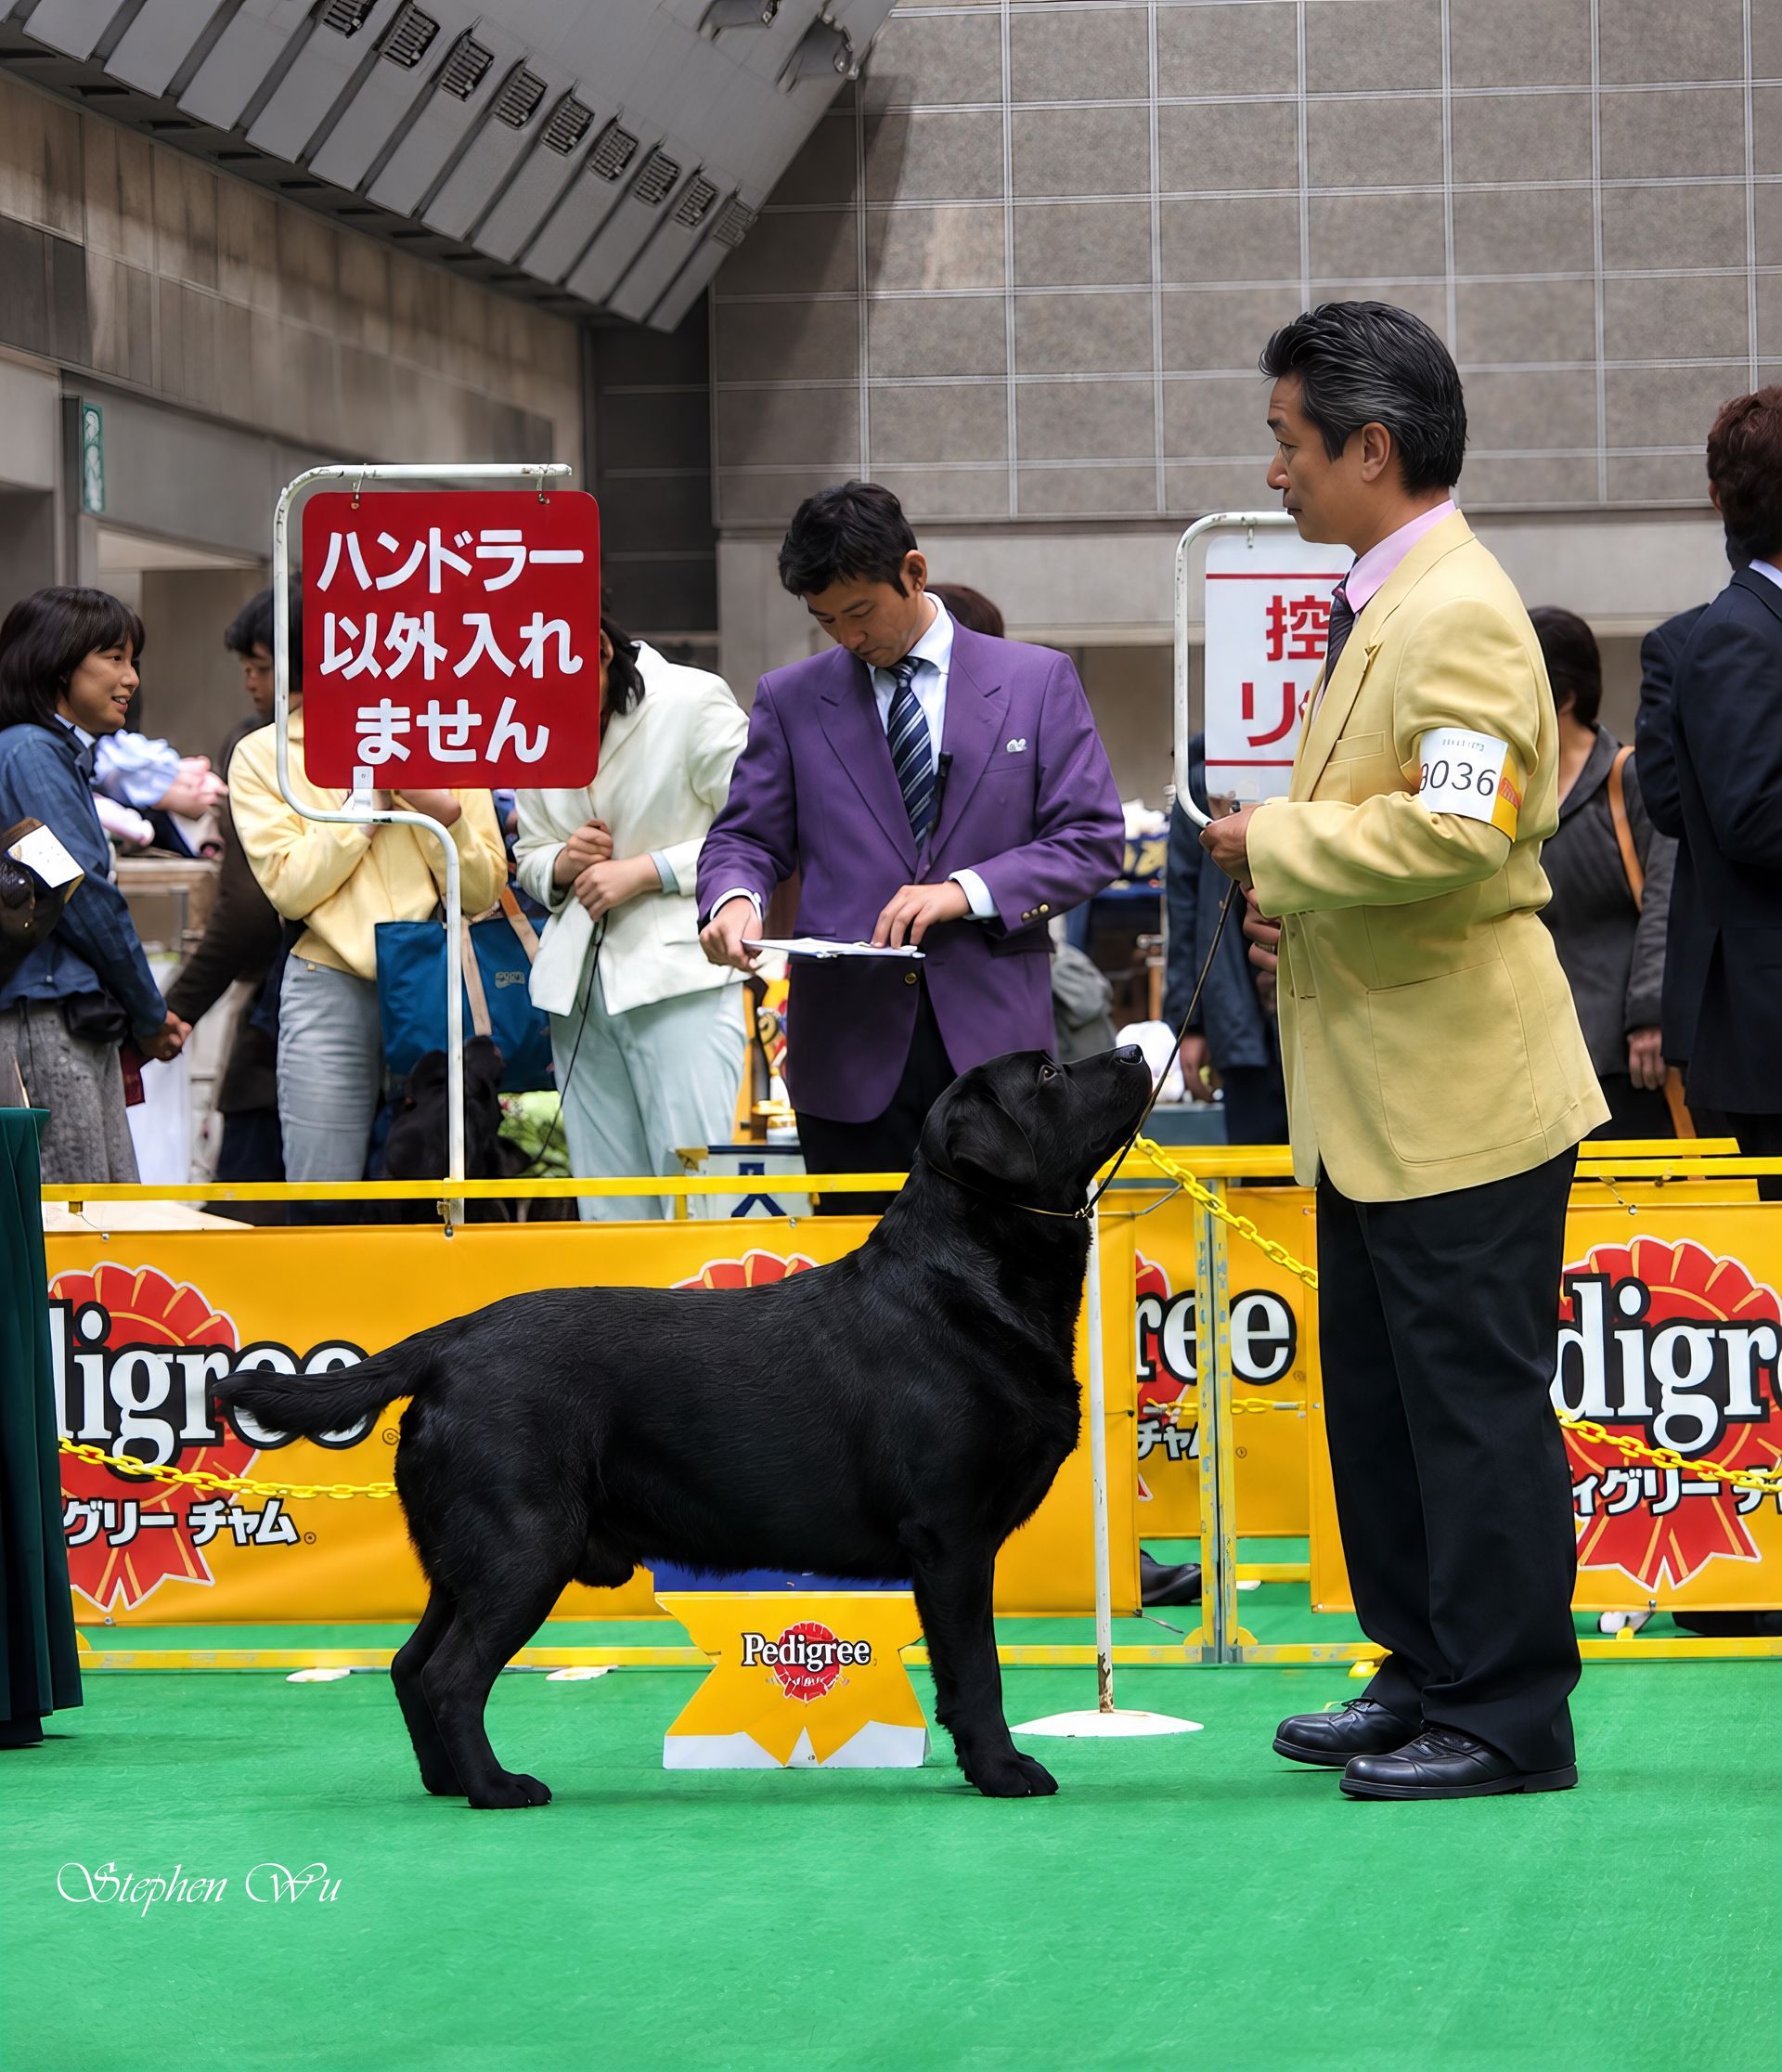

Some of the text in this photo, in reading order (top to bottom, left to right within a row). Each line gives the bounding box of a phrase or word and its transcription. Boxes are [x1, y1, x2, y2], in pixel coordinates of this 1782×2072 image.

[316, 526, 586, 594] ハンドラー
[318, 610, 584, 681] 以外入れ
[355, 696, 550, 766] ません
[1241, 681, 1311, 748] リ
[187, 1499, 301, 1546] チャム
[742, 1633, 872, 1674] Pedigree
